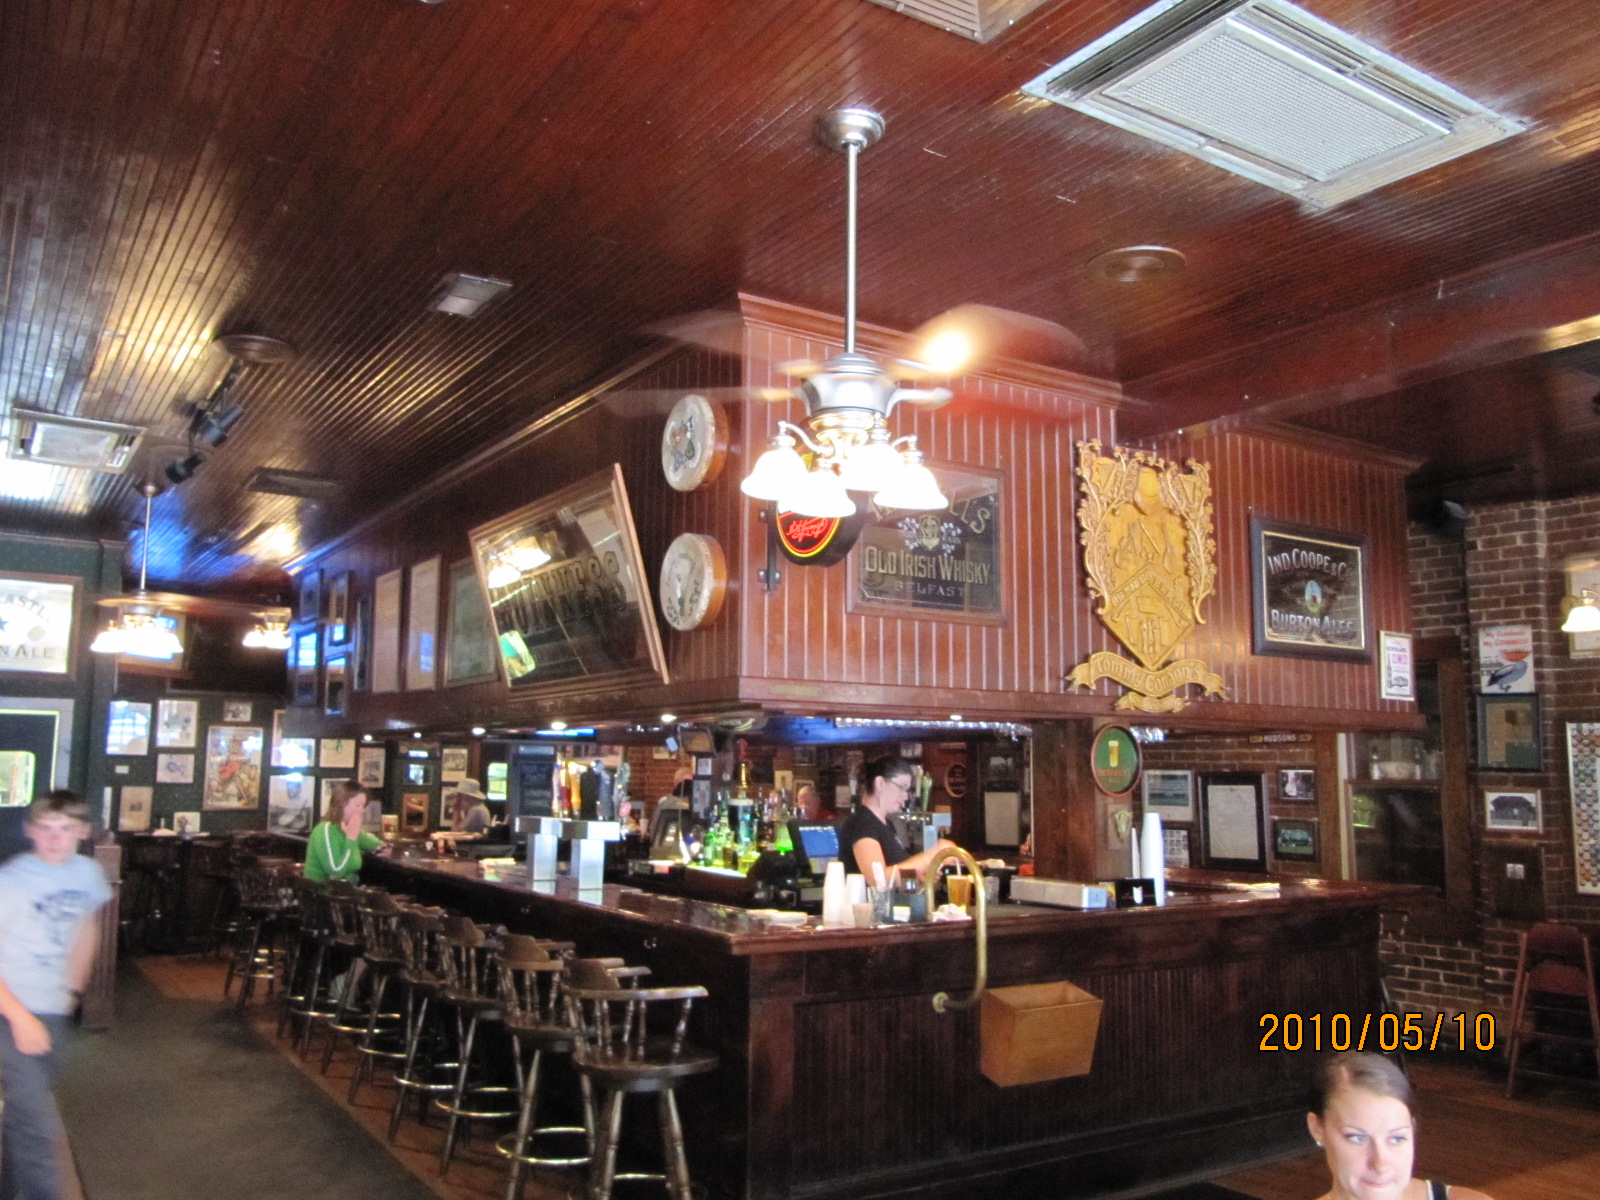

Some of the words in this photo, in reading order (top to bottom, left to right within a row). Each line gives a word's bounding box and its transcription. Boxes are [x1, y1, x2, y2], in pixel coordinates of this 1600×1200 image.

[865, 546, 897, 575] OLD
[900, 550, 937, 580] IRISH
[938, 554, 991, 585] WHISKY
[1292, 548, 1331, 573] COOPE
[895, 580, 966, 597] BELFAST
[1271, 609, 1320, 632] BURTON
[15, 644, 54, 660] ALE
[1096, 658, 1143, 688] Tommy
